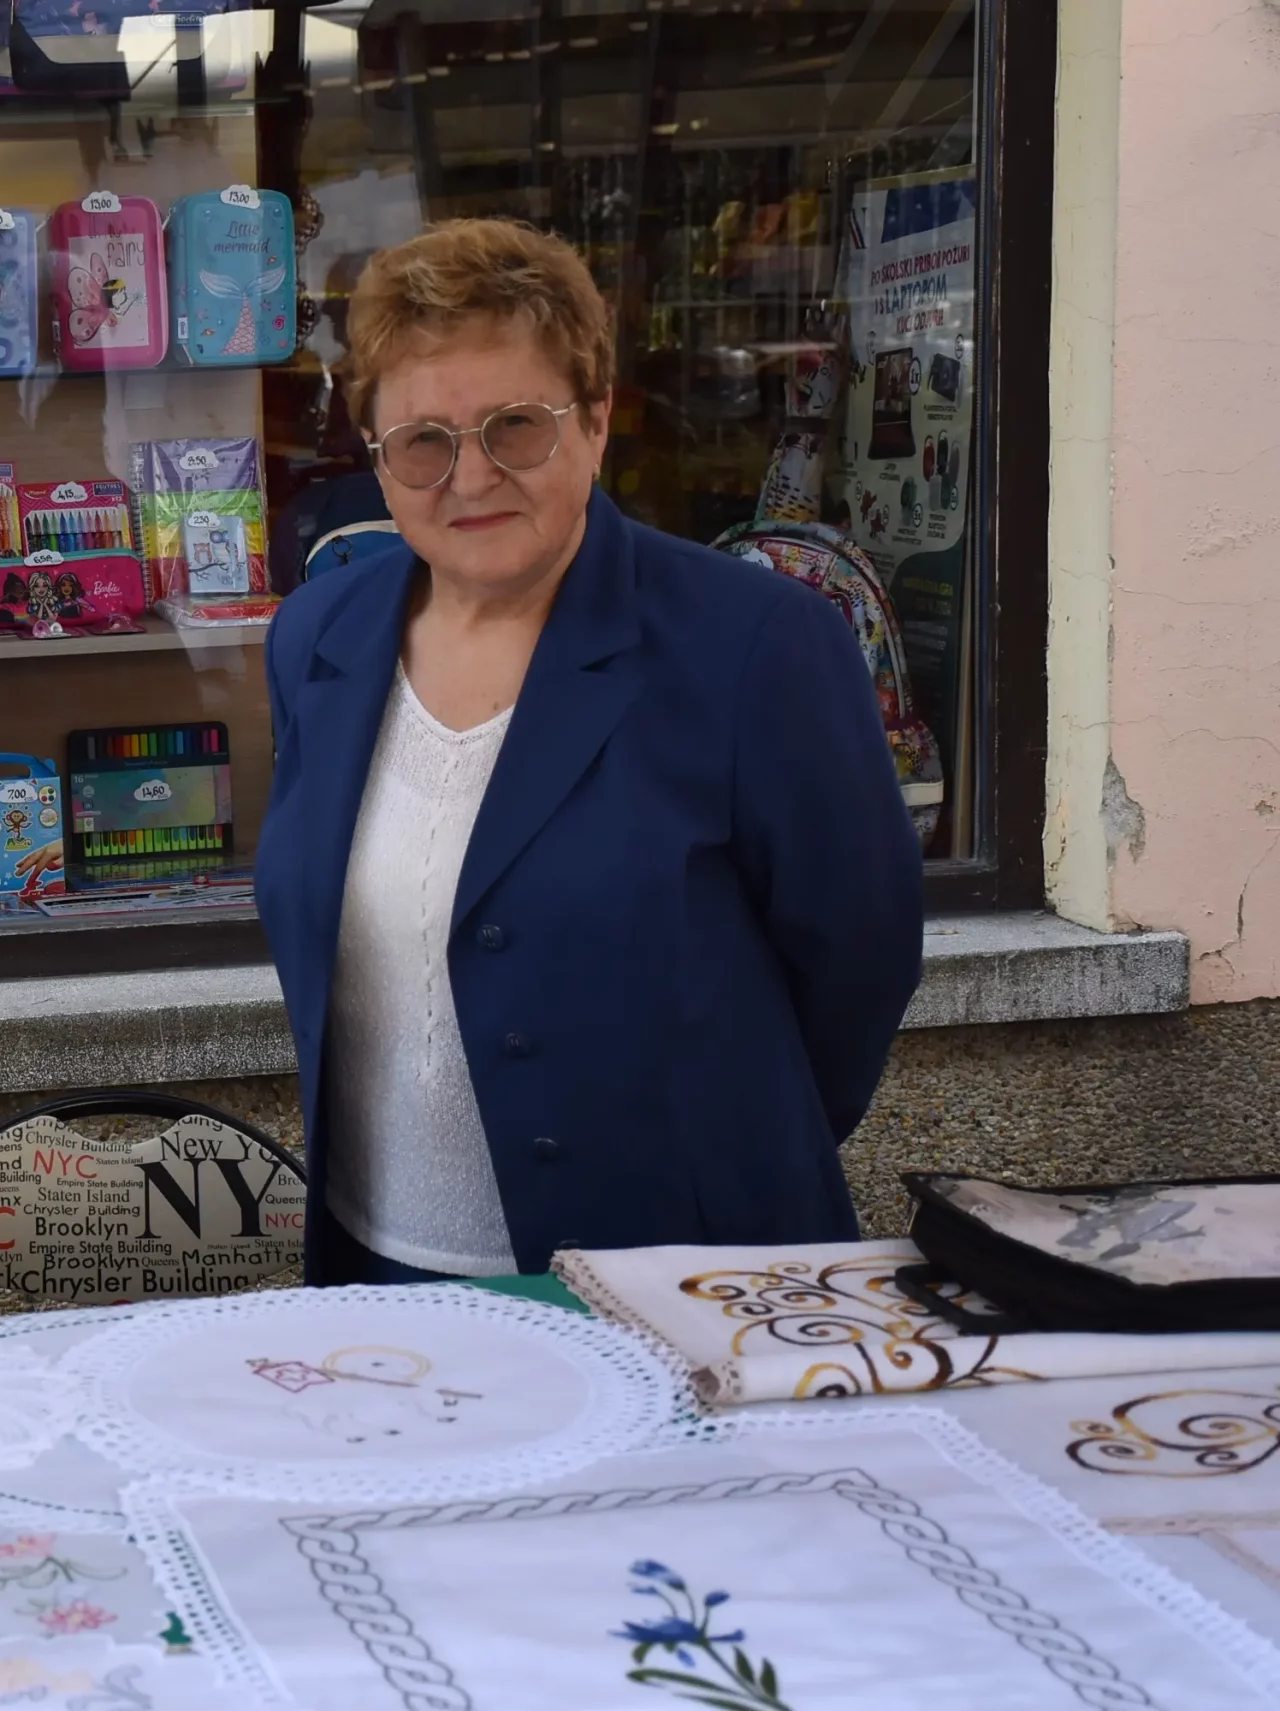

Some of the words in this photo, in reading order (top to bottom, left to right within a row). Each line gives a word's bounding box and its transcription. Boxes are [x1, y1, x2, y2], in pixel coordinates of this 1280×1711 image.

[213, 237, 271, 254] mermaid
[73, 774, 84, 784] 16
[25, 1131, 78, 1149] Chrysler
[80, 1140, 133, 1154] Building
[160, 1130, 223, 1161] New
[32, 1148, 98, 1179] NYC
[120, 1156, 144, 1165] Island
[0, 1170, 42, 1185] Building
[56, 1177, 85, 1188] Empire
[87, 1179, 108, 1188] State
[110, 1180, 144, 1190] Building
[37, 1186, 81, 1202] Staten
[86, 1189, 131, 1203] Island
[133, 1157, 284, 1240] NY
[23, 1203, 80, 1217] Chrysler
[87, 1205, 141, 1217] Building
[35, 1216, 128, 1241] Brooklyn
[265, 1212, 304, 1229] NYC
[29, 1240, 75, 1257] Empire
[79, 1240, 114, 1254] State
[117, 1240, 172, 1256] Building
[254, 1238, 285, 1249] Staten
[44, 1252, 140, 1272] Brooklyn
[141, 1256, 180, 1267] Queens
[21, 1269, 133, 1300] Chrysler
